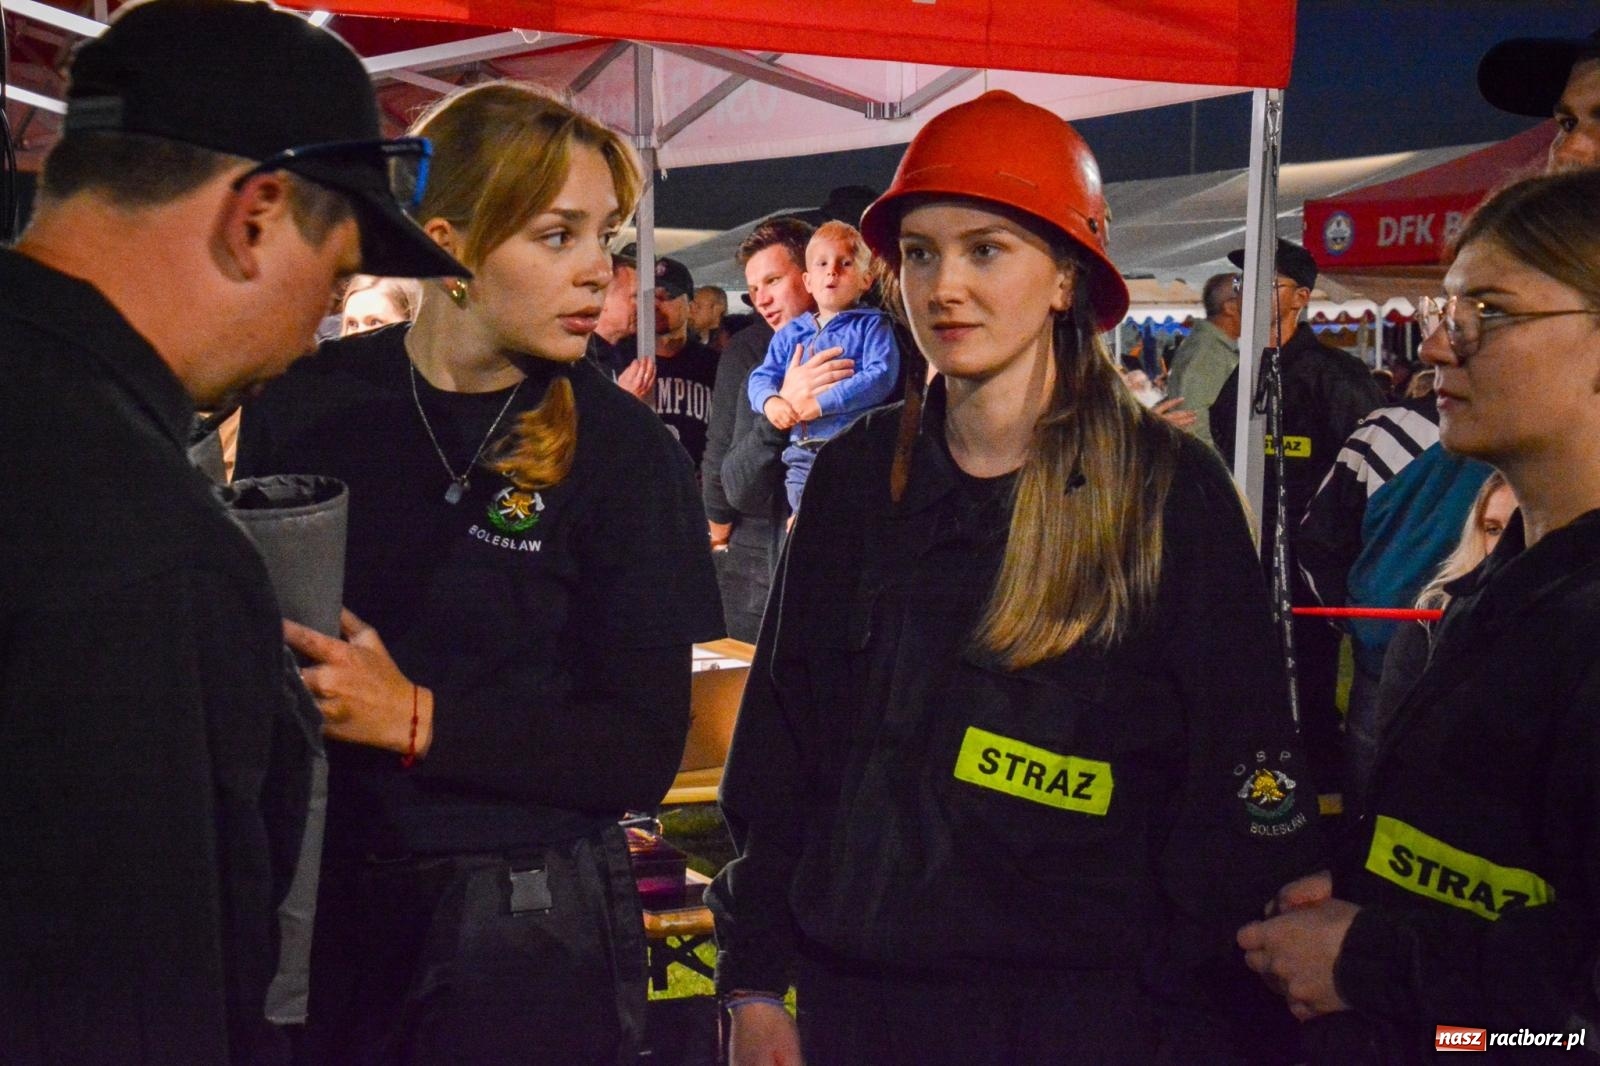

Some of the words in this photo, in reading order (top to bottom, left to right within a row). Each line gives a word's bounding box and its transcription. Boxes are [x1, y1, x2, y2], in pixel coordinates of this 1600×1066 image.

[1377, 213, 1435, 246] DFK
[1444, 210, 1463, 244] B
[468, 524, 542, 553] BOLESŁAW
